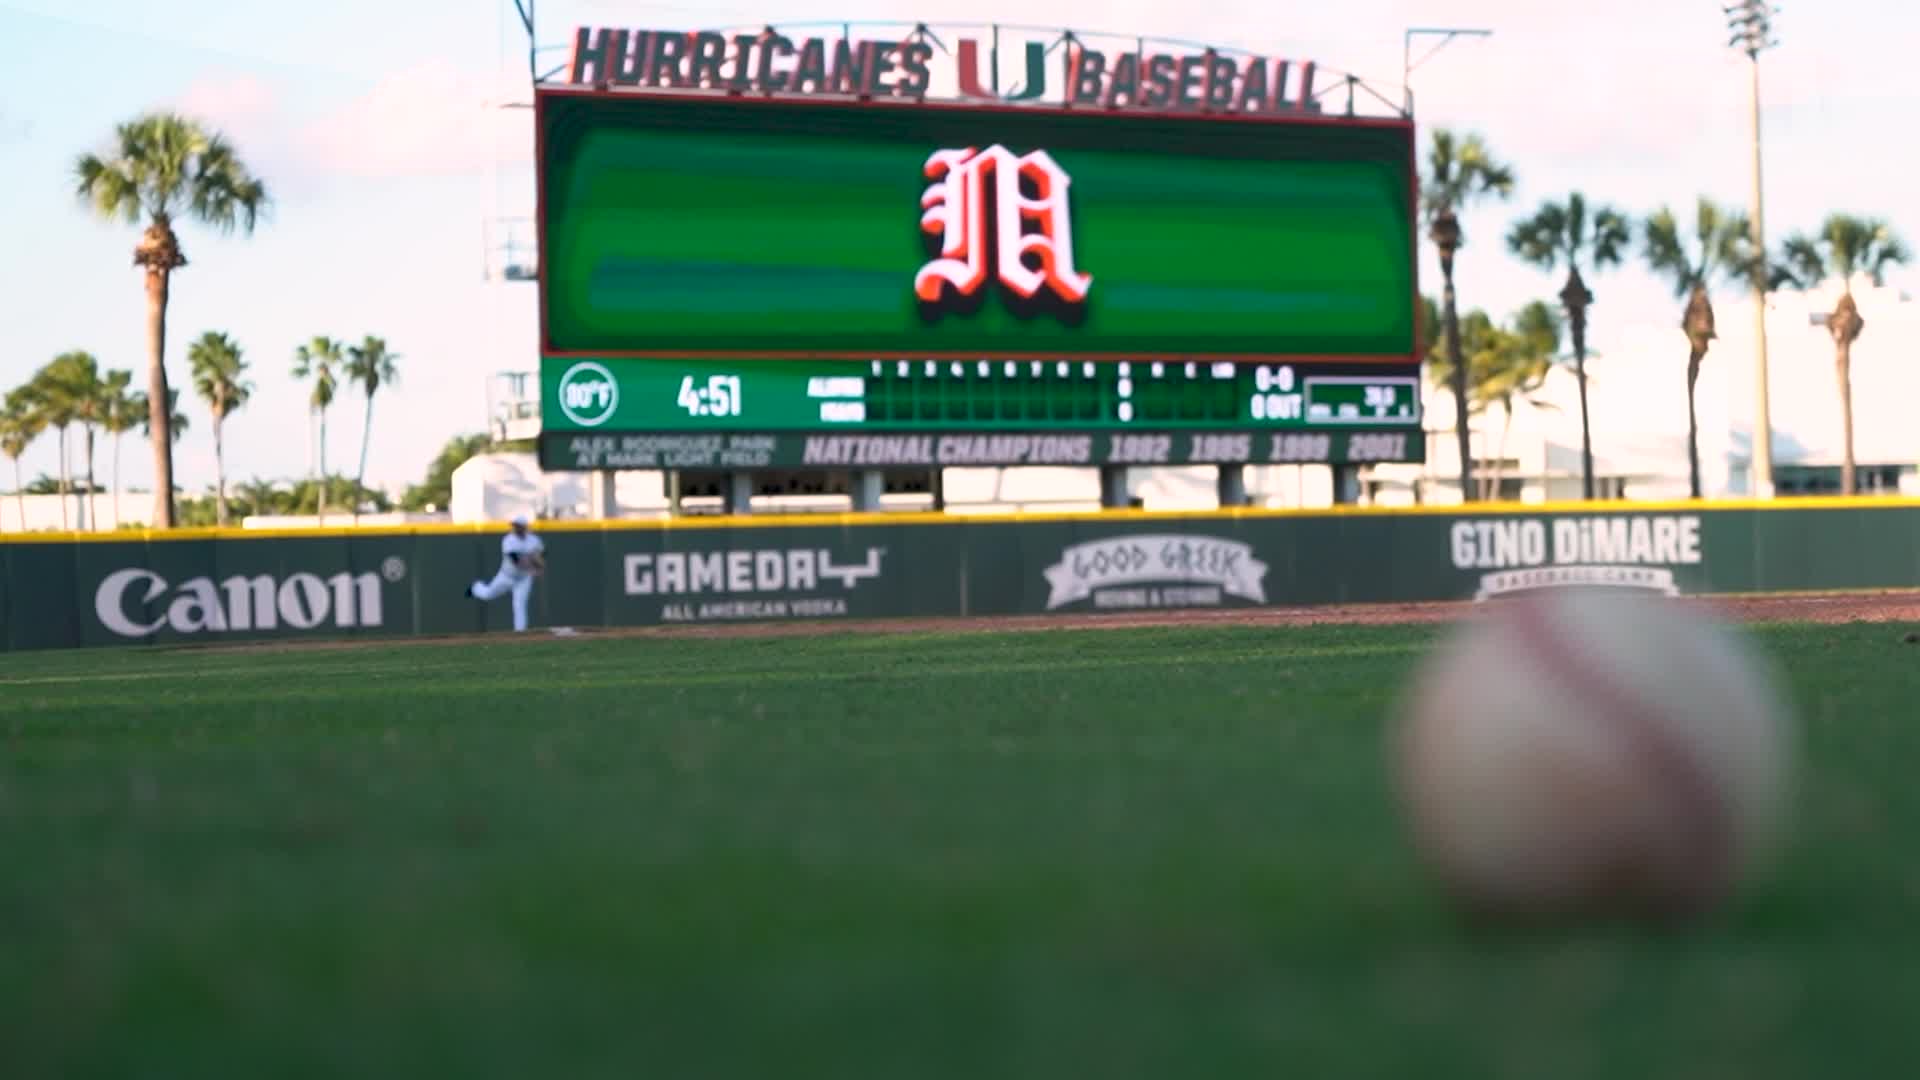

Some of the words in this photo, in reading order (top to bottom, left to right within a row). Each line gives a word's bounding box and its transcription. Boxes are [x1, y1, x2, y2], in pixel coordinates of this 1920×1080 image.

[569, 27, 932, 97] HURRICANES
[958, 39, 1045, 100] U
[1068, 46, 1322, 113] BASEBALL
[677, 375, 741, 417] 4:51
[1255, 365, 1294, 391] 0-0
[803, 435, 934, 464] NATIONAL
[936, 435, 1092, 463] CHAMPIONS
[1347, 434, 1405, 461] 2001
[1073, 544, 1147, 579] GOOD
[1159, 542, 1242, 575] GREEK
[1451, 519, 1546, 568] GINO
[624, 548, 882, 594] GAMEDAY
[95, 567, 384, 637] Canon
[661, 604, 695, 620] ALL
